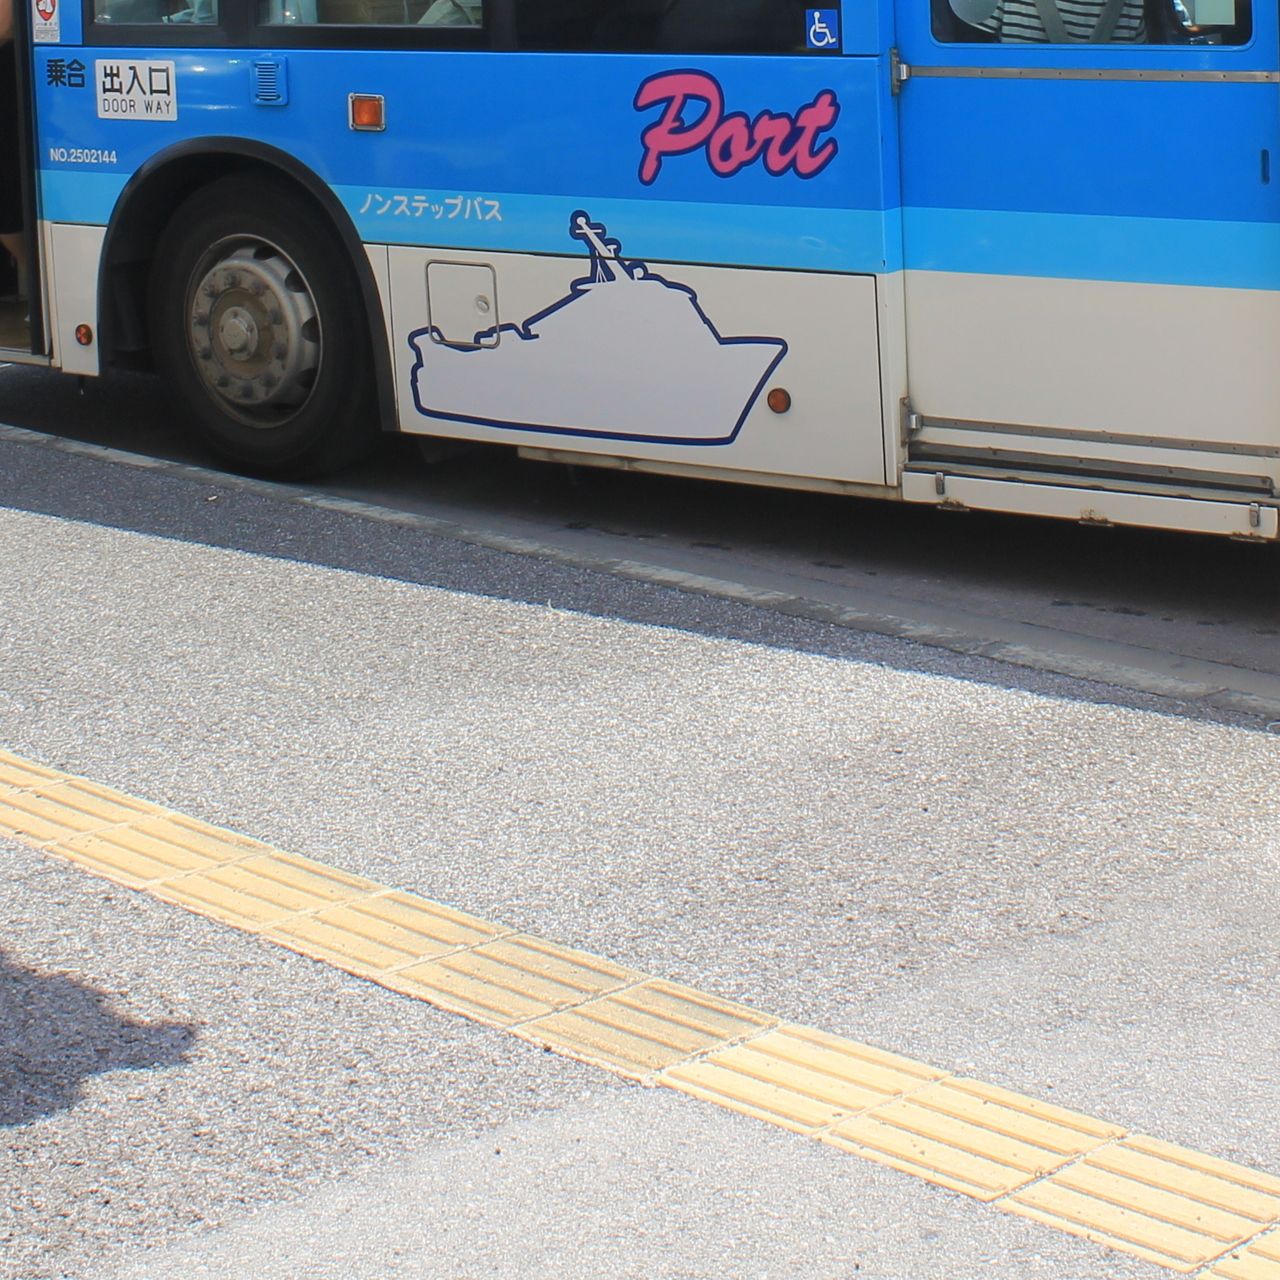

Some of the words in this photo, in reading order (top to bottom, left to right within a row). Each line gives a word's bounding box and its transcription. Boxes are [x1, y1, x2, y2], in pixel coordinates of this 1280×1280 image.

[46, 58, 86, 88] 乗合
[102, 65, 170, 96] 出入口
[103, 98, 136, 113] DOOR
[144, 99, 171, 114] WAY
[633, 68, 841, 186] Port
[50, 148, 118, 163] NO.2502144
[359, 193, 503, 221] ノンステップバス
